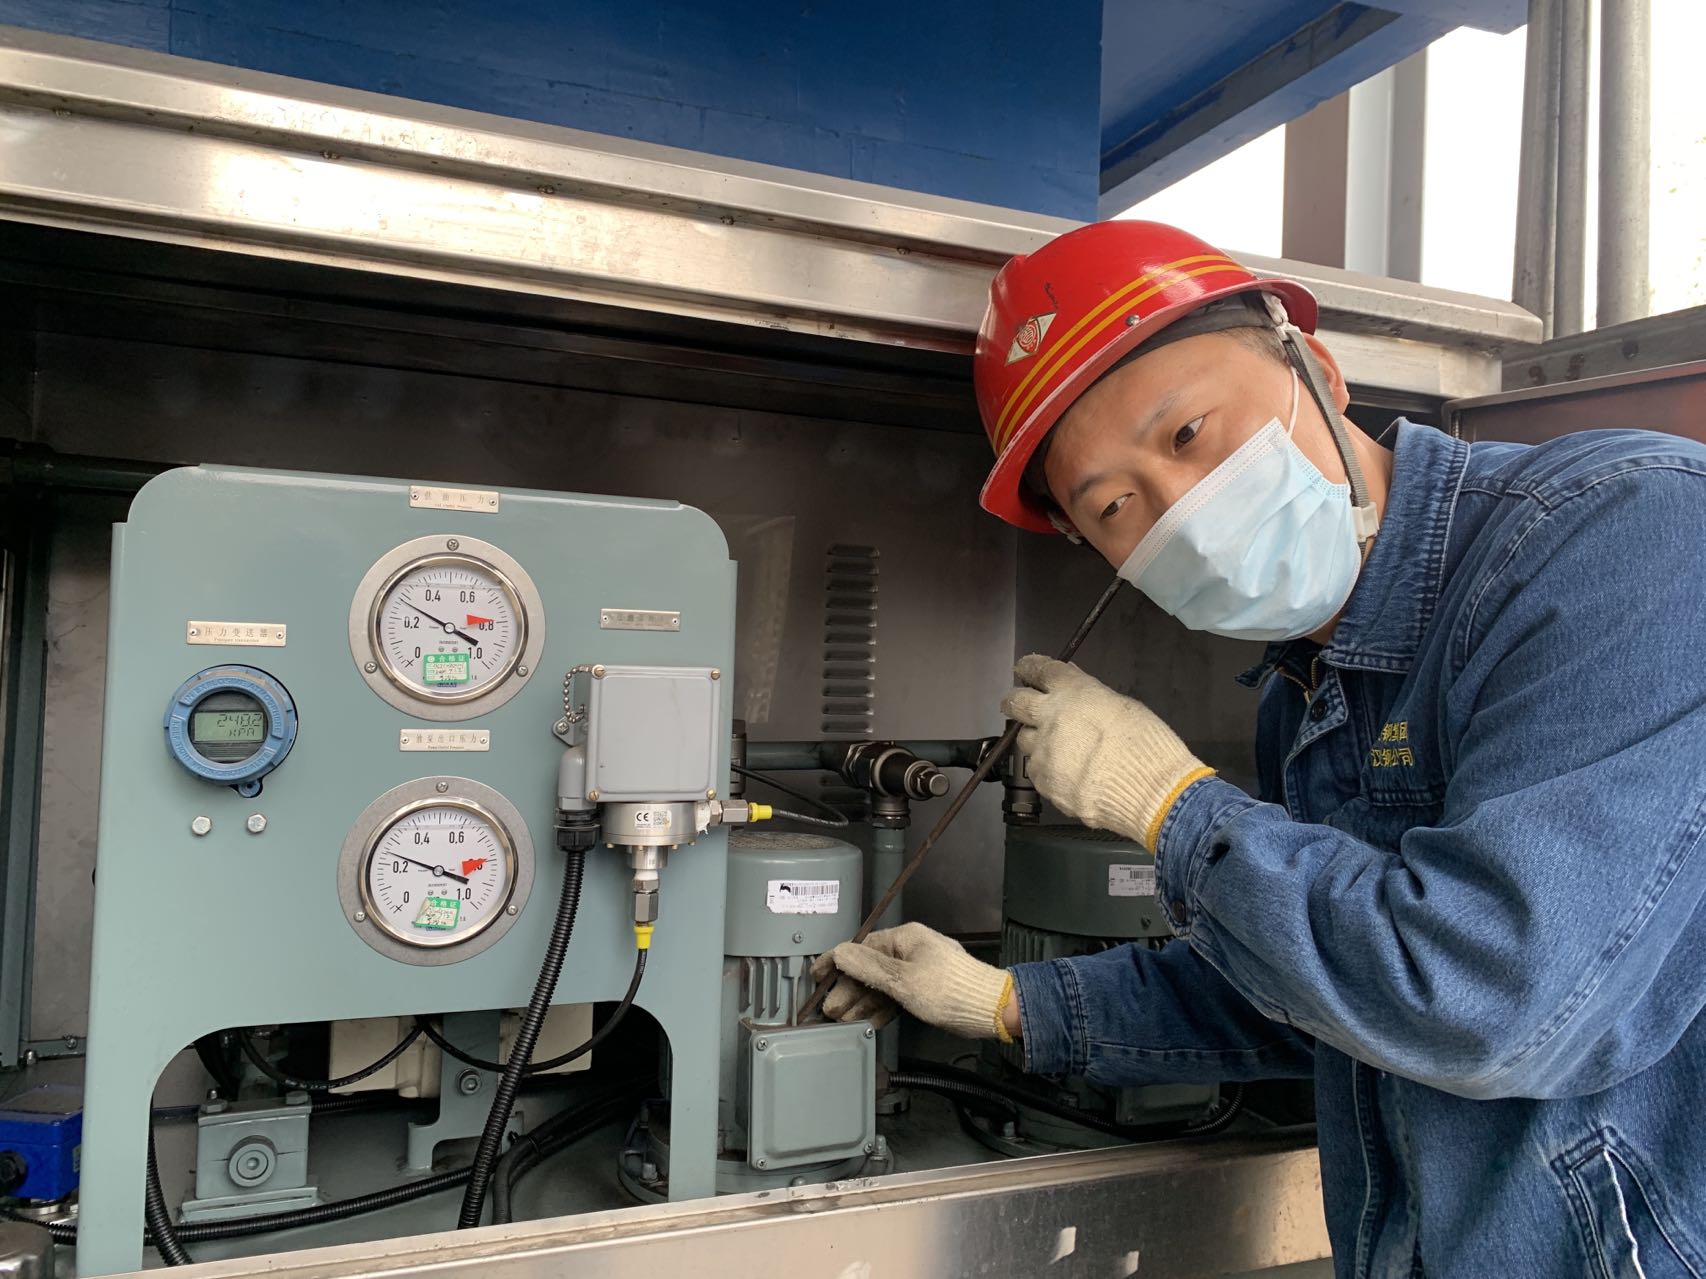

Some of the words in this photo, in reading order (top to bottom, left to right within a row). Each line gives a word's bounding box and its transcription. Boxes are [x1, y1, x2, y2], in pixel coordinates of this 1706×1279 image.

[425, 589, 441, 602] 0.4
[460, 591, 475, 603] 0.6
[404, 616, 420, 629] 0.2
[205, 627, 268, 638] 压力变送器
[468, 647, 482, 659] 1.0
[414, 832, 430, 845] 0.4
[449, 831, 464, 844] 0.6
[392, 861, 408, 873] 0.2
[457, 888, 471, 900] 1.0
